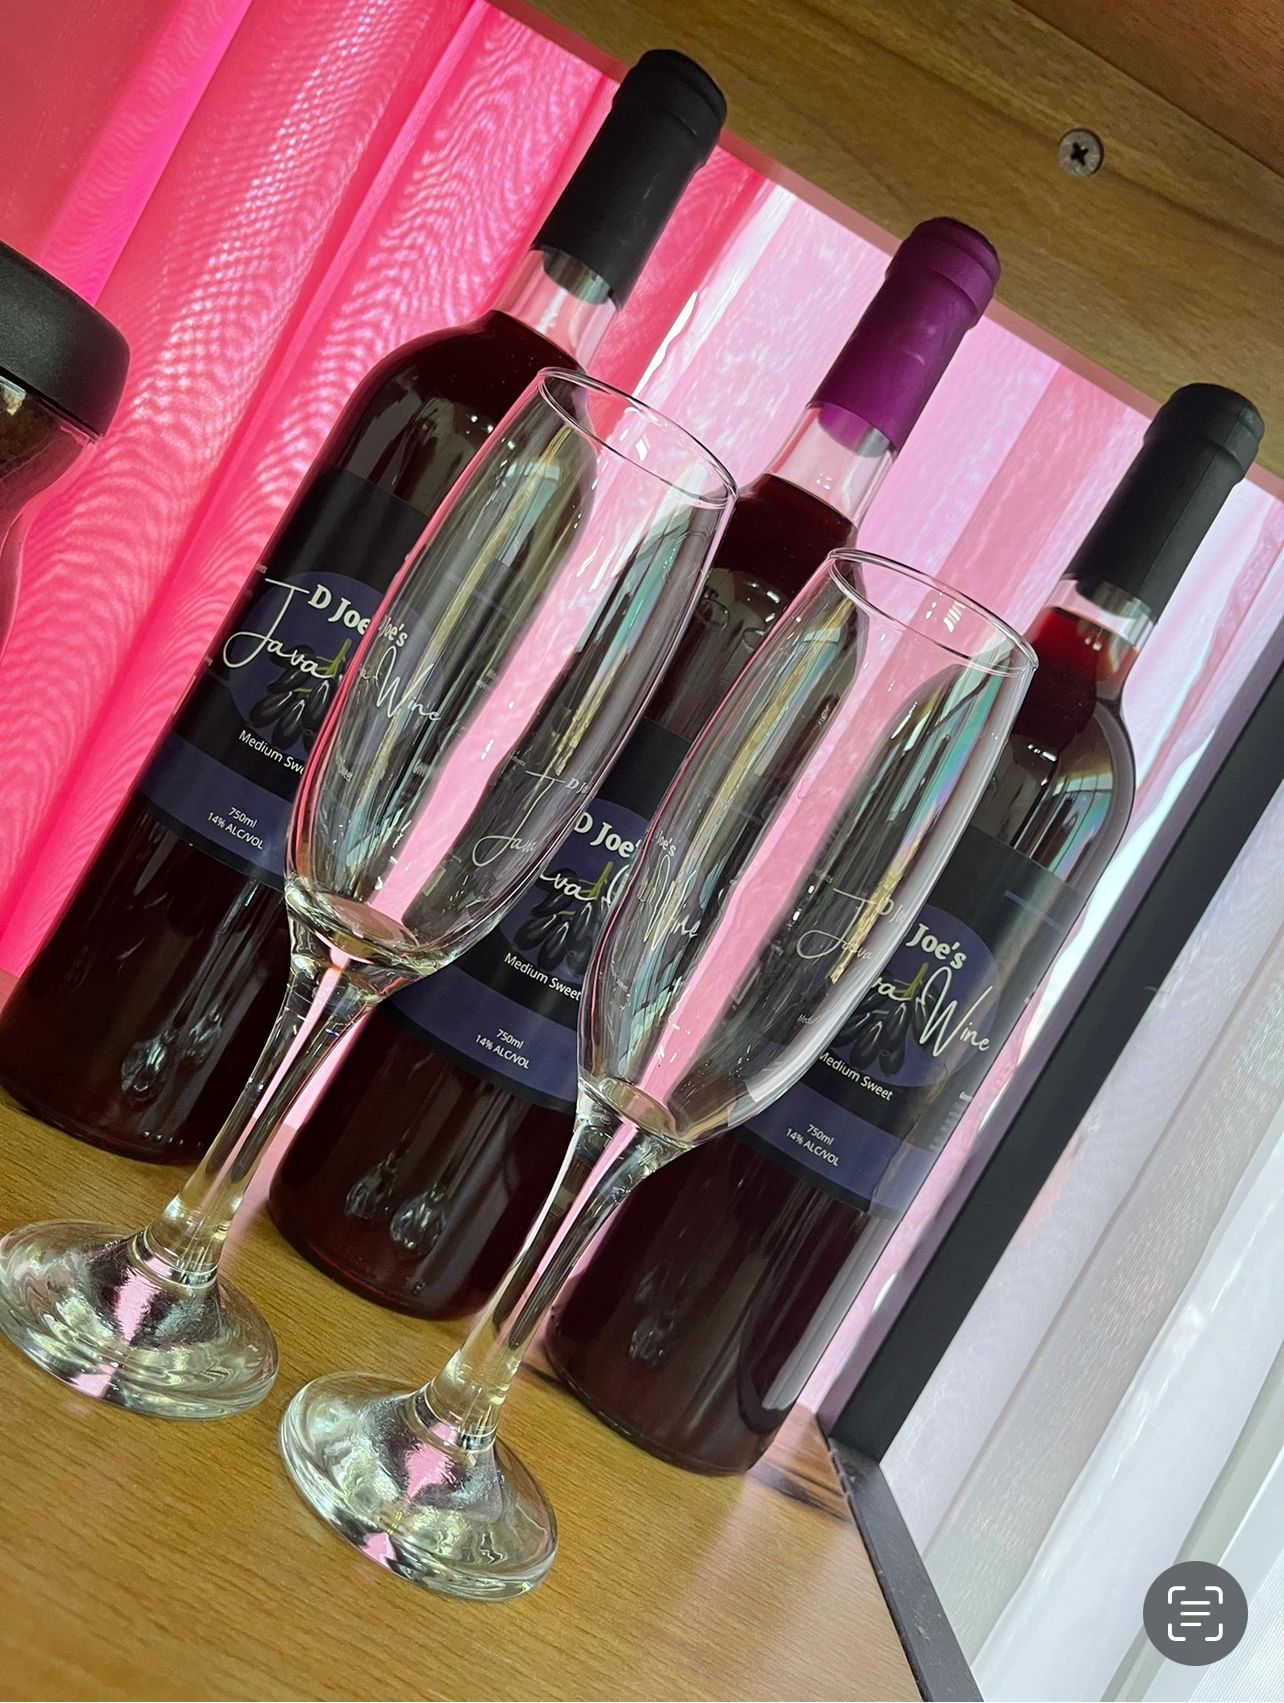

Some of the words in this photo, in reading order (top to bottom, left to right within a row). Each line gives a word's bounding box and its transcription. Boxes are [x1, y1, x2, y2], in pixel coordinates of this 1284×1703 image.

[222, 578, 333, 679] Java
[308, 584, 332, 609] D
[328, 597, 371, 636] Joe
[239, 730, 283, 762] Medium
[208, 812, 226, 828] 14%
[225, 824, 263, 850] ALC/VOL
[229, 807, 258, 828] 750ml
[574, 812, 593, 833] D
[590, 822, 641, 858] Joe'
[906, 923, 967, 969] Joe's
[504, 953, 548, 984] Medium
[549, 978, 582, 1001] Sweet
[916, 966, 993, 1057] Wine
[476, 1034, 493, 1050] 14%
[493, 1045, 529, 1069] ALC/VOL
[496, 1029, 525, 1049] 750ml
[820, 1052, 860, 1082] Medium
[860, 1076, 893, 1101] Sweet
[786, 1128, 804, 1145] 14%
[803, 1140, 840, 1166] ALC/VOL
[807, 1124, 834, 1145] 750ml
